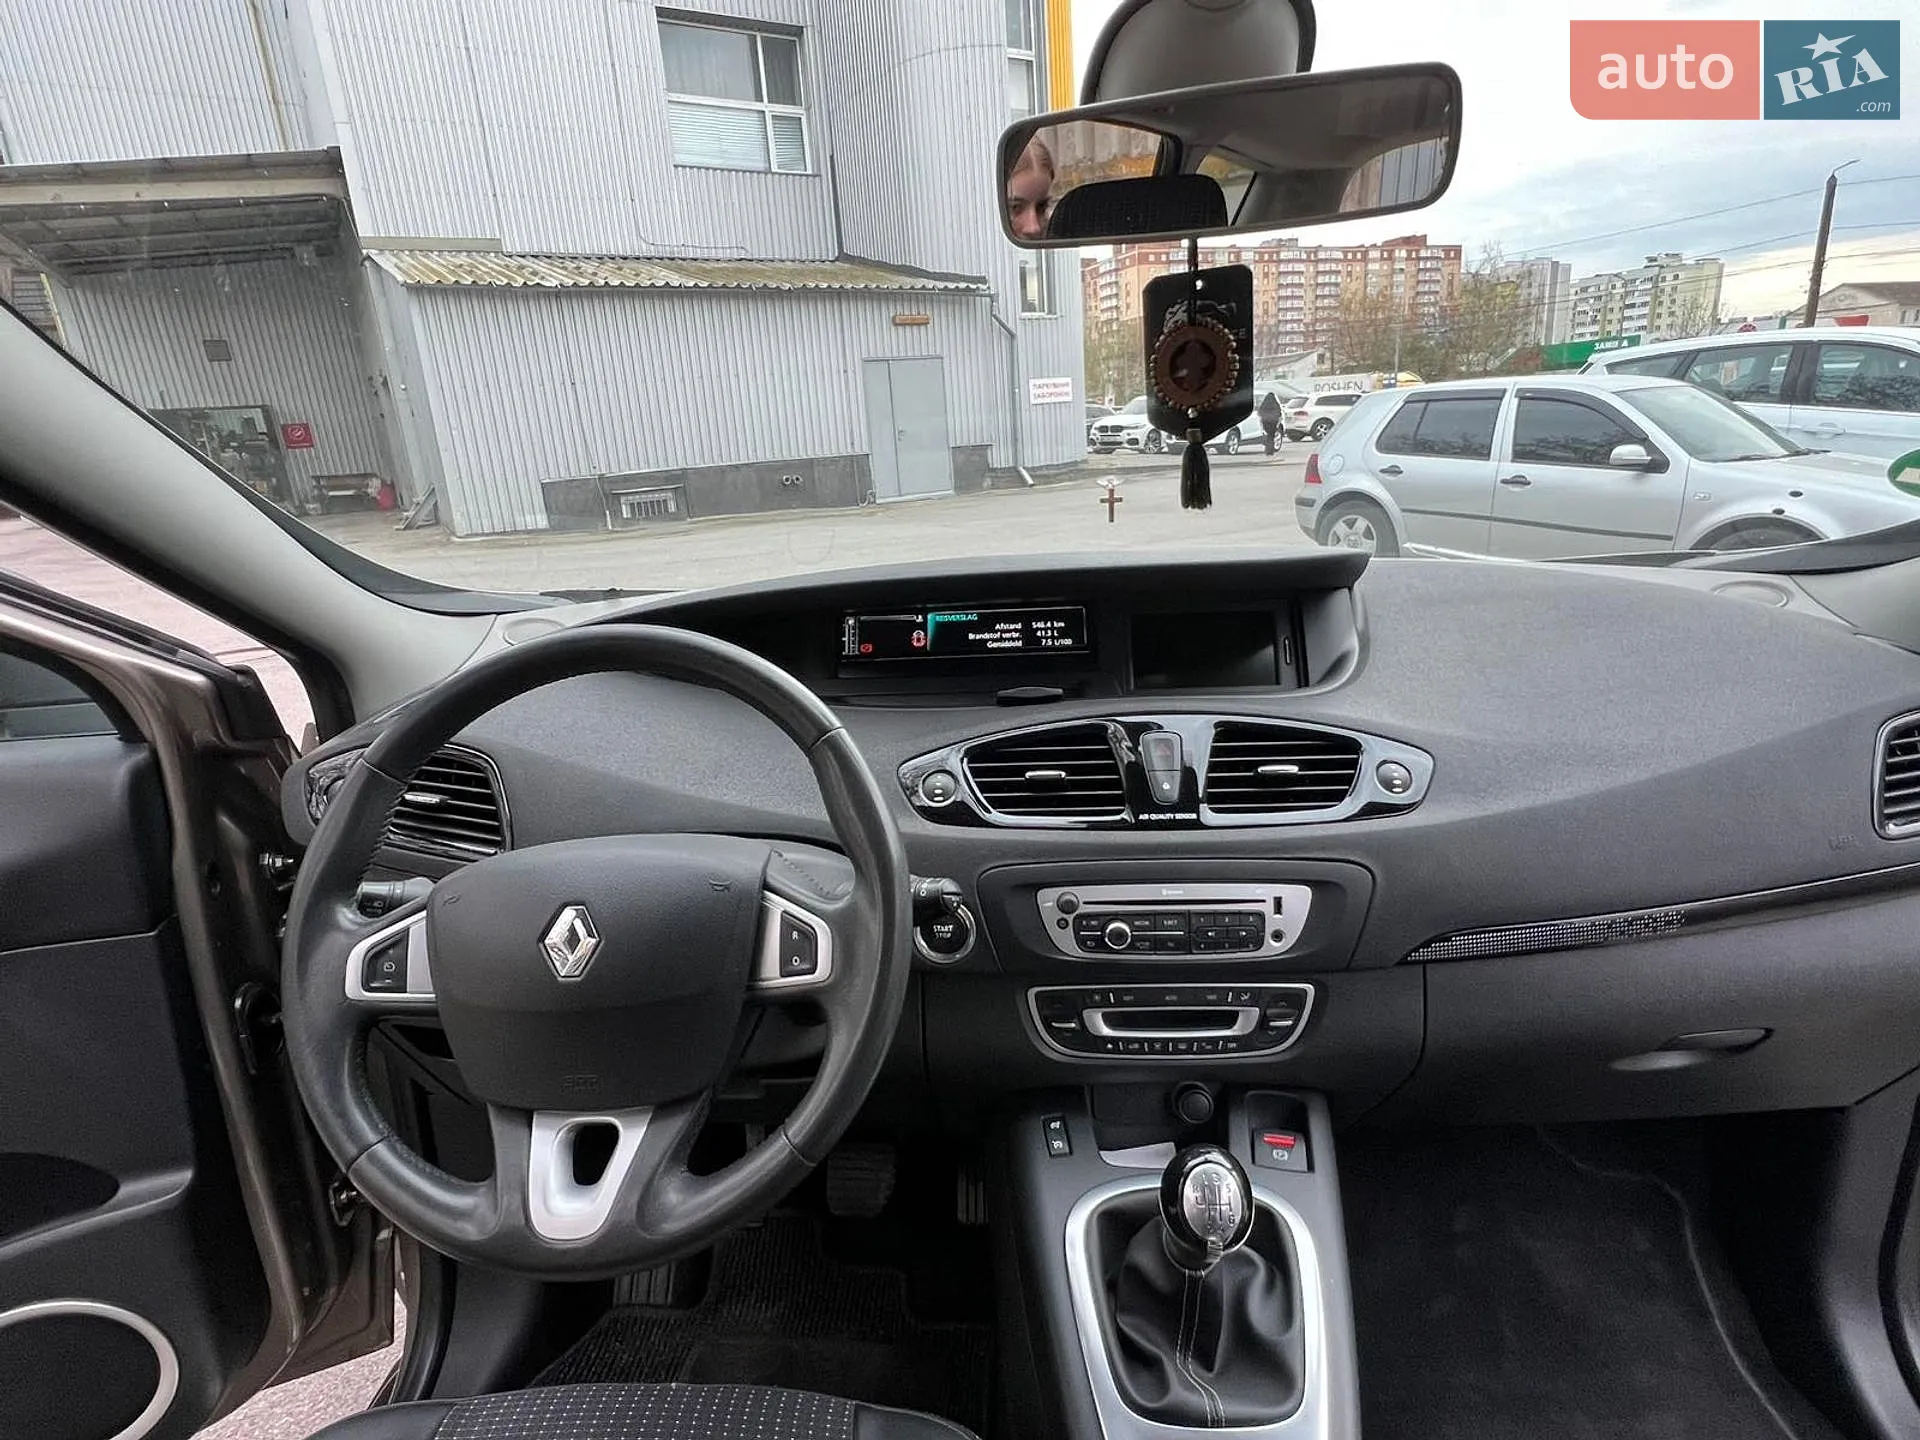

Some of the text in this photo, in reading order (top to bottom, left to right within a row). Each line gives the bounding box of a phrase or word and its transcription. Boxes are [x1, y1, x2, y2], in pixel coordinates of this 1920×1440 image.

[994, 622, 1022, 631] Afstand
[1053, 620, 1066, 628] km
[933, 924, 954, 932] START
[791, 930, 799, 940] R
